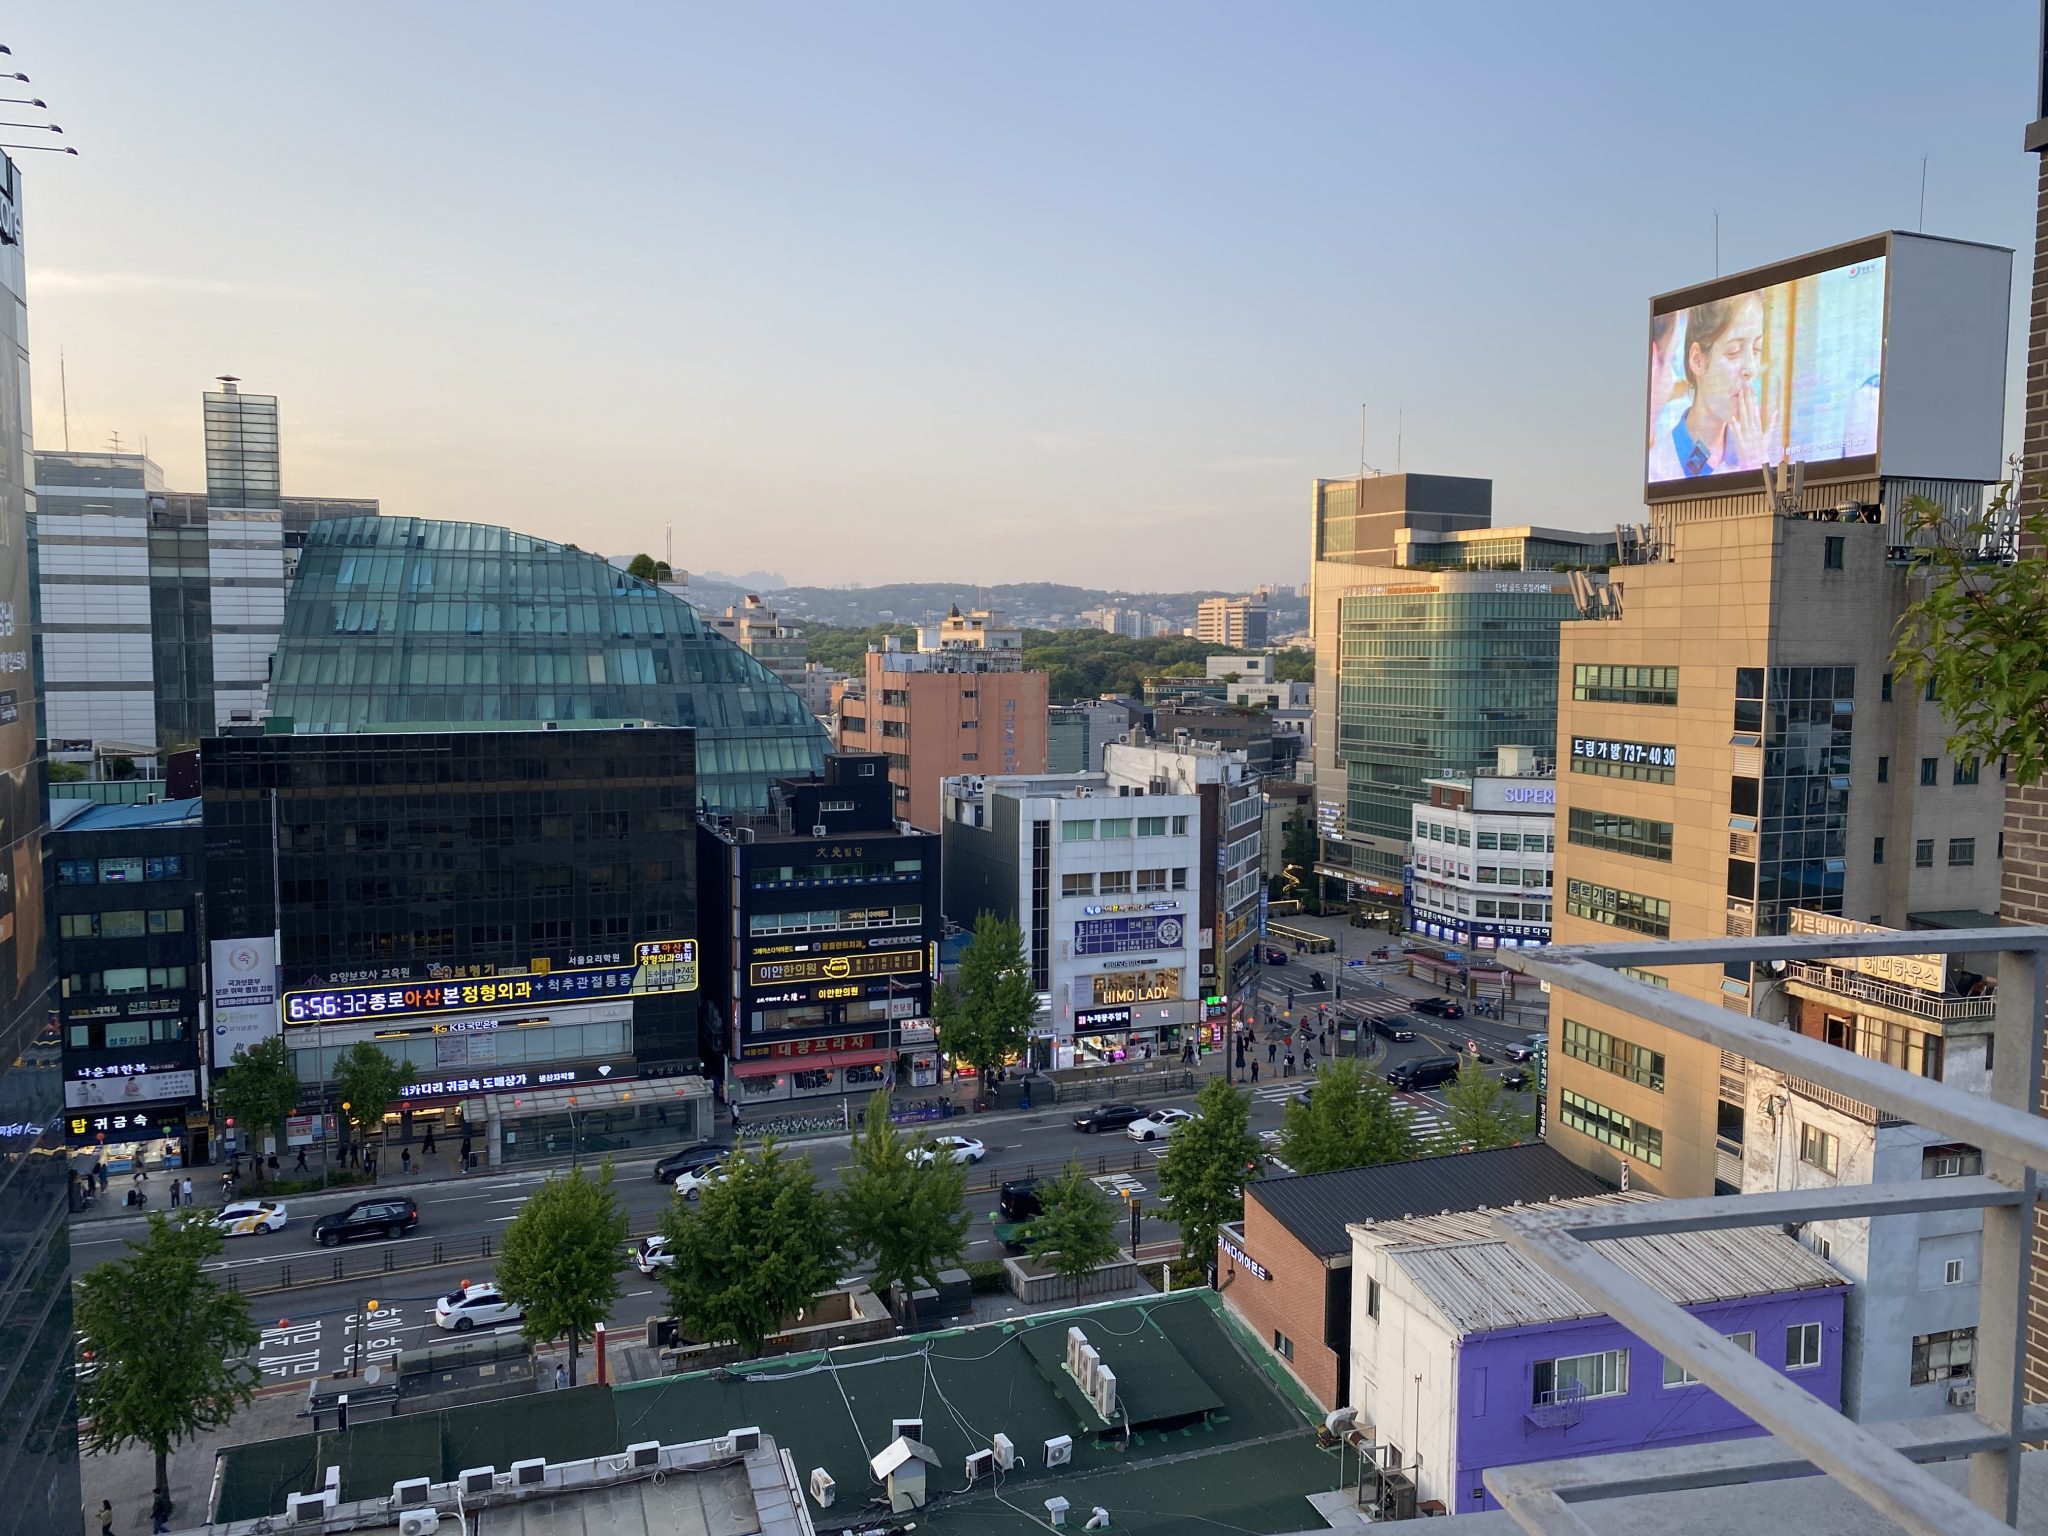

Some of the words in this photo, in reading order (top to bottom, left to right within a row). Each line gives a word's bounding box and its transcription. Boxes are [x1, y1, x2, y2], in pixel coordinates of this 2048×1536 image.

[1495, 583, 1508, 593] 단성
[1508, 583, 1521, 592] 골드
[1522, 583, 1551, 593] 주얼리센터
[1574, 740, 1621, 760] 드림가발
[1624, 744, 1675, 766] 737-4030
[1505, 788, 1556, 803] SUPER
[1569, 881, 1616, 904] 종로기업
[640, 942, 692, 955] 종로아산본
[568, 953, 620, 966] 서울요리학원
[640, 953, 692, 966] 정형외과의원
[329, 970, 379, 983] 요양보호사
[381, 967, 410, 979] 교육원
[676, 974, 696, 982] 7575
[760, 962, 817, 979] 이안한의원
[1864, 956, 1939, 987] 해피하우스
[547, 973, 631, 992] 척추관절통증
[818, 986, 859, 999] 이안한의원
[1103, 988, 1135, 1005] HIMO
[1138, 986, 1169, 1003] LADY
[290, 993, 366, 1019] 6:56:32
[893, 1003, 912, 1012] 전당포
[779, 1036, 864, 1056] 대광프라자
[446, 1078, 480, 1091] 귀금속
[483, 1074, 527, 1088] 도매상가
[94, 1113, 148, 1130] 귀금속
